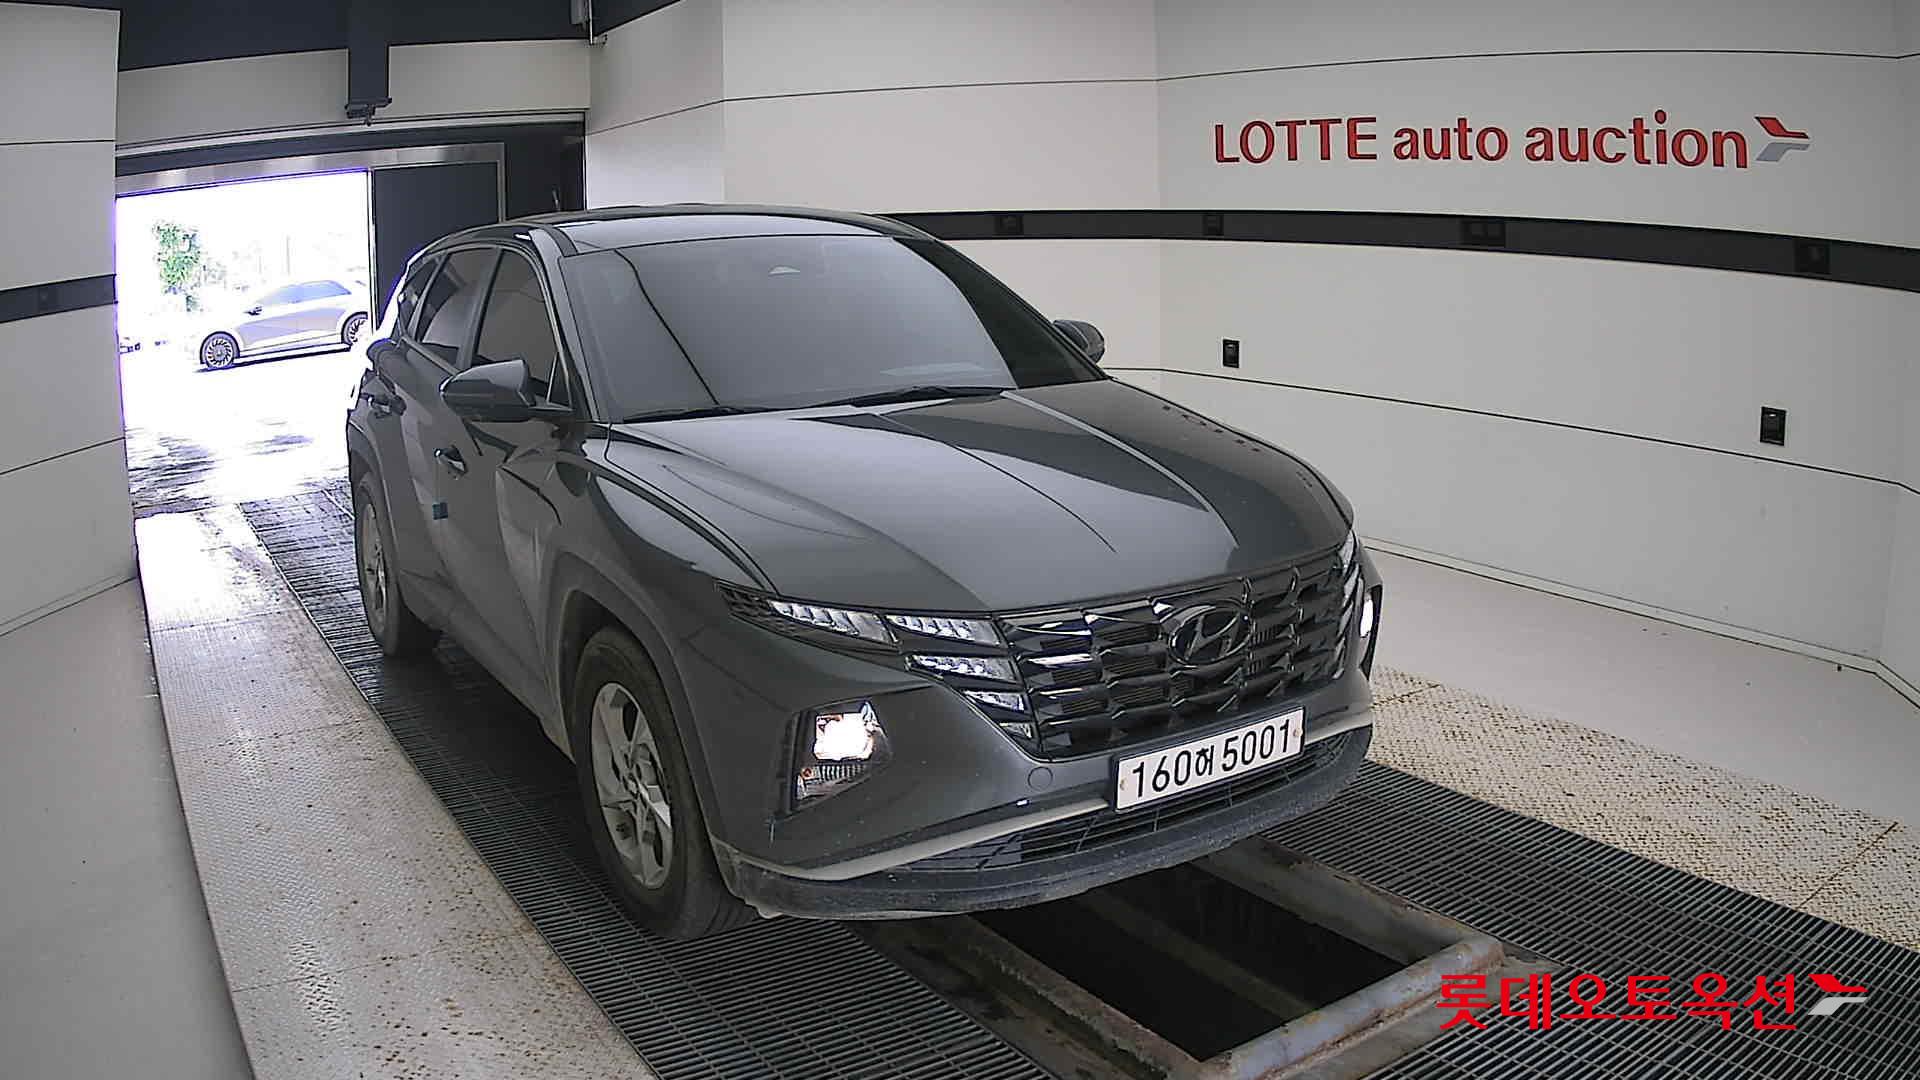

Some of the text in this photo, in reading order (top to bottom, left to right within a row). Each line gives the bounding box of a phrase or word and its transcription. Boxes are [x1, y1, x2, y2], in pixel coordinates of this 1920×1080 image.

[1214, 109, 1748, 169] LOTTE auto auction
[1132, 719, 1290, 798] 160허 5001
